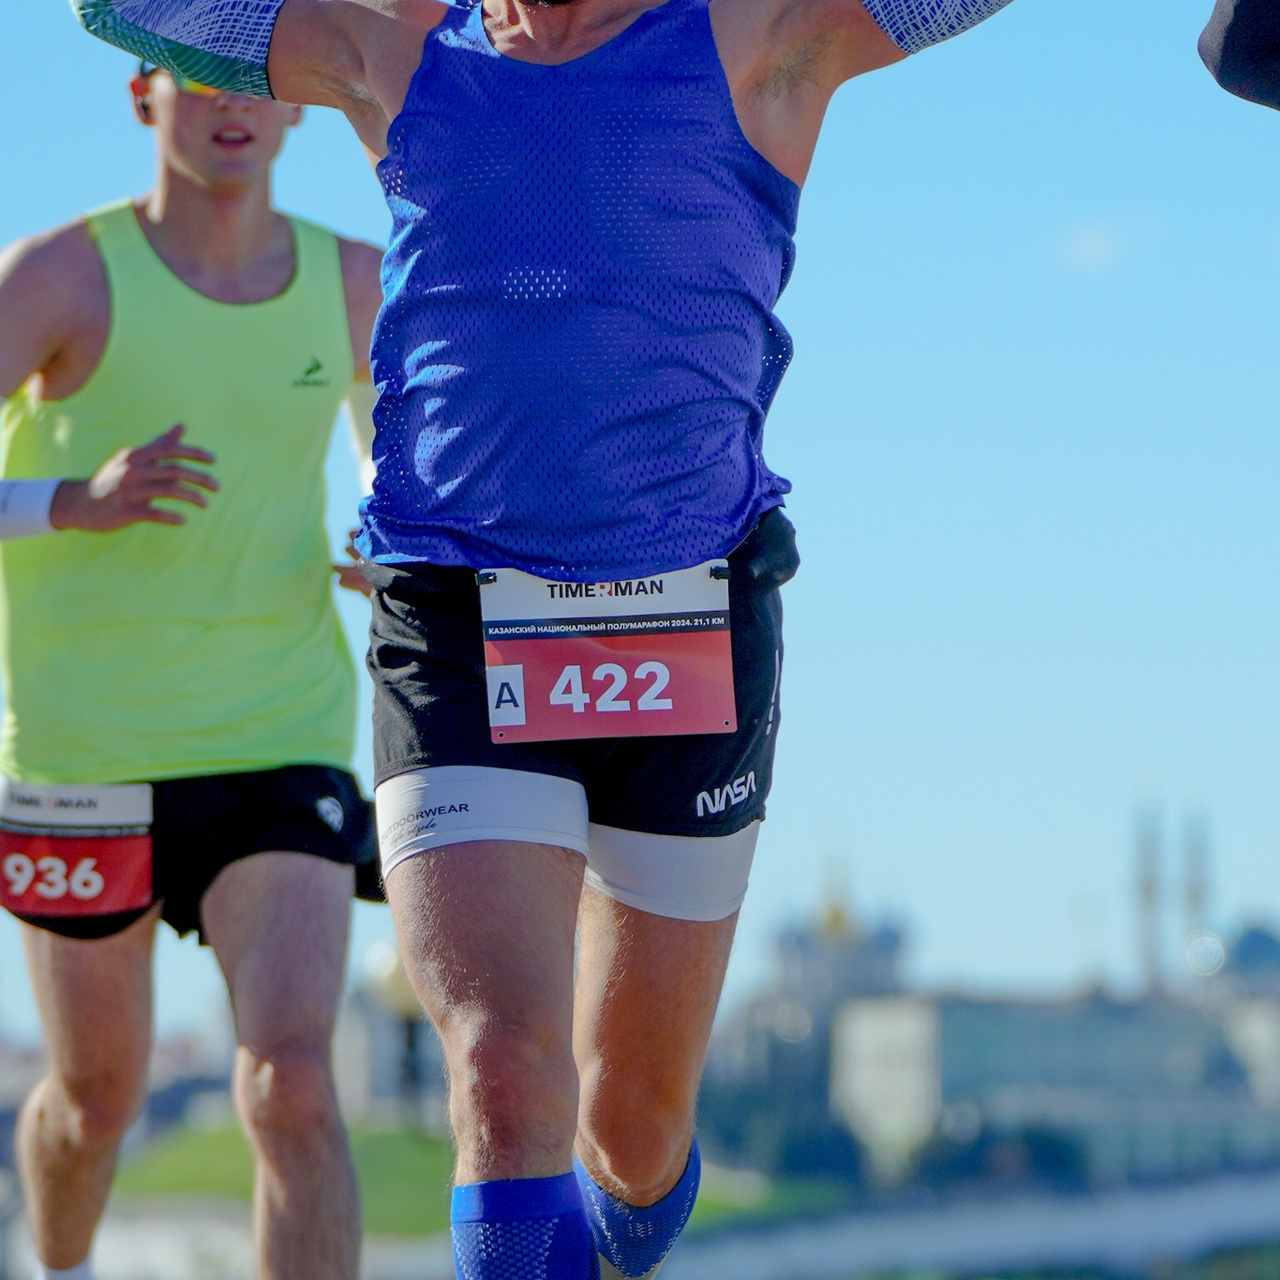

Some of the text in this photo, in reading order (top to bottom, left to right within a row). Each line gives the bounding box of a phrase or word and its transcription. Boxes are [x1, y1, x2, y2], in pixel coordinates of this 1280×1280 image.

[487, 617, 725, 635] КАЗАНСКИЙ НАЦИОНАЛЬНЫЙ ПОЛУМАРАФОН 2024. 21,1 КМ
[494, 661, 673, 713] A 422
[696, 771, 757, 817] NASA
[2, 853, 105, 900] 936
